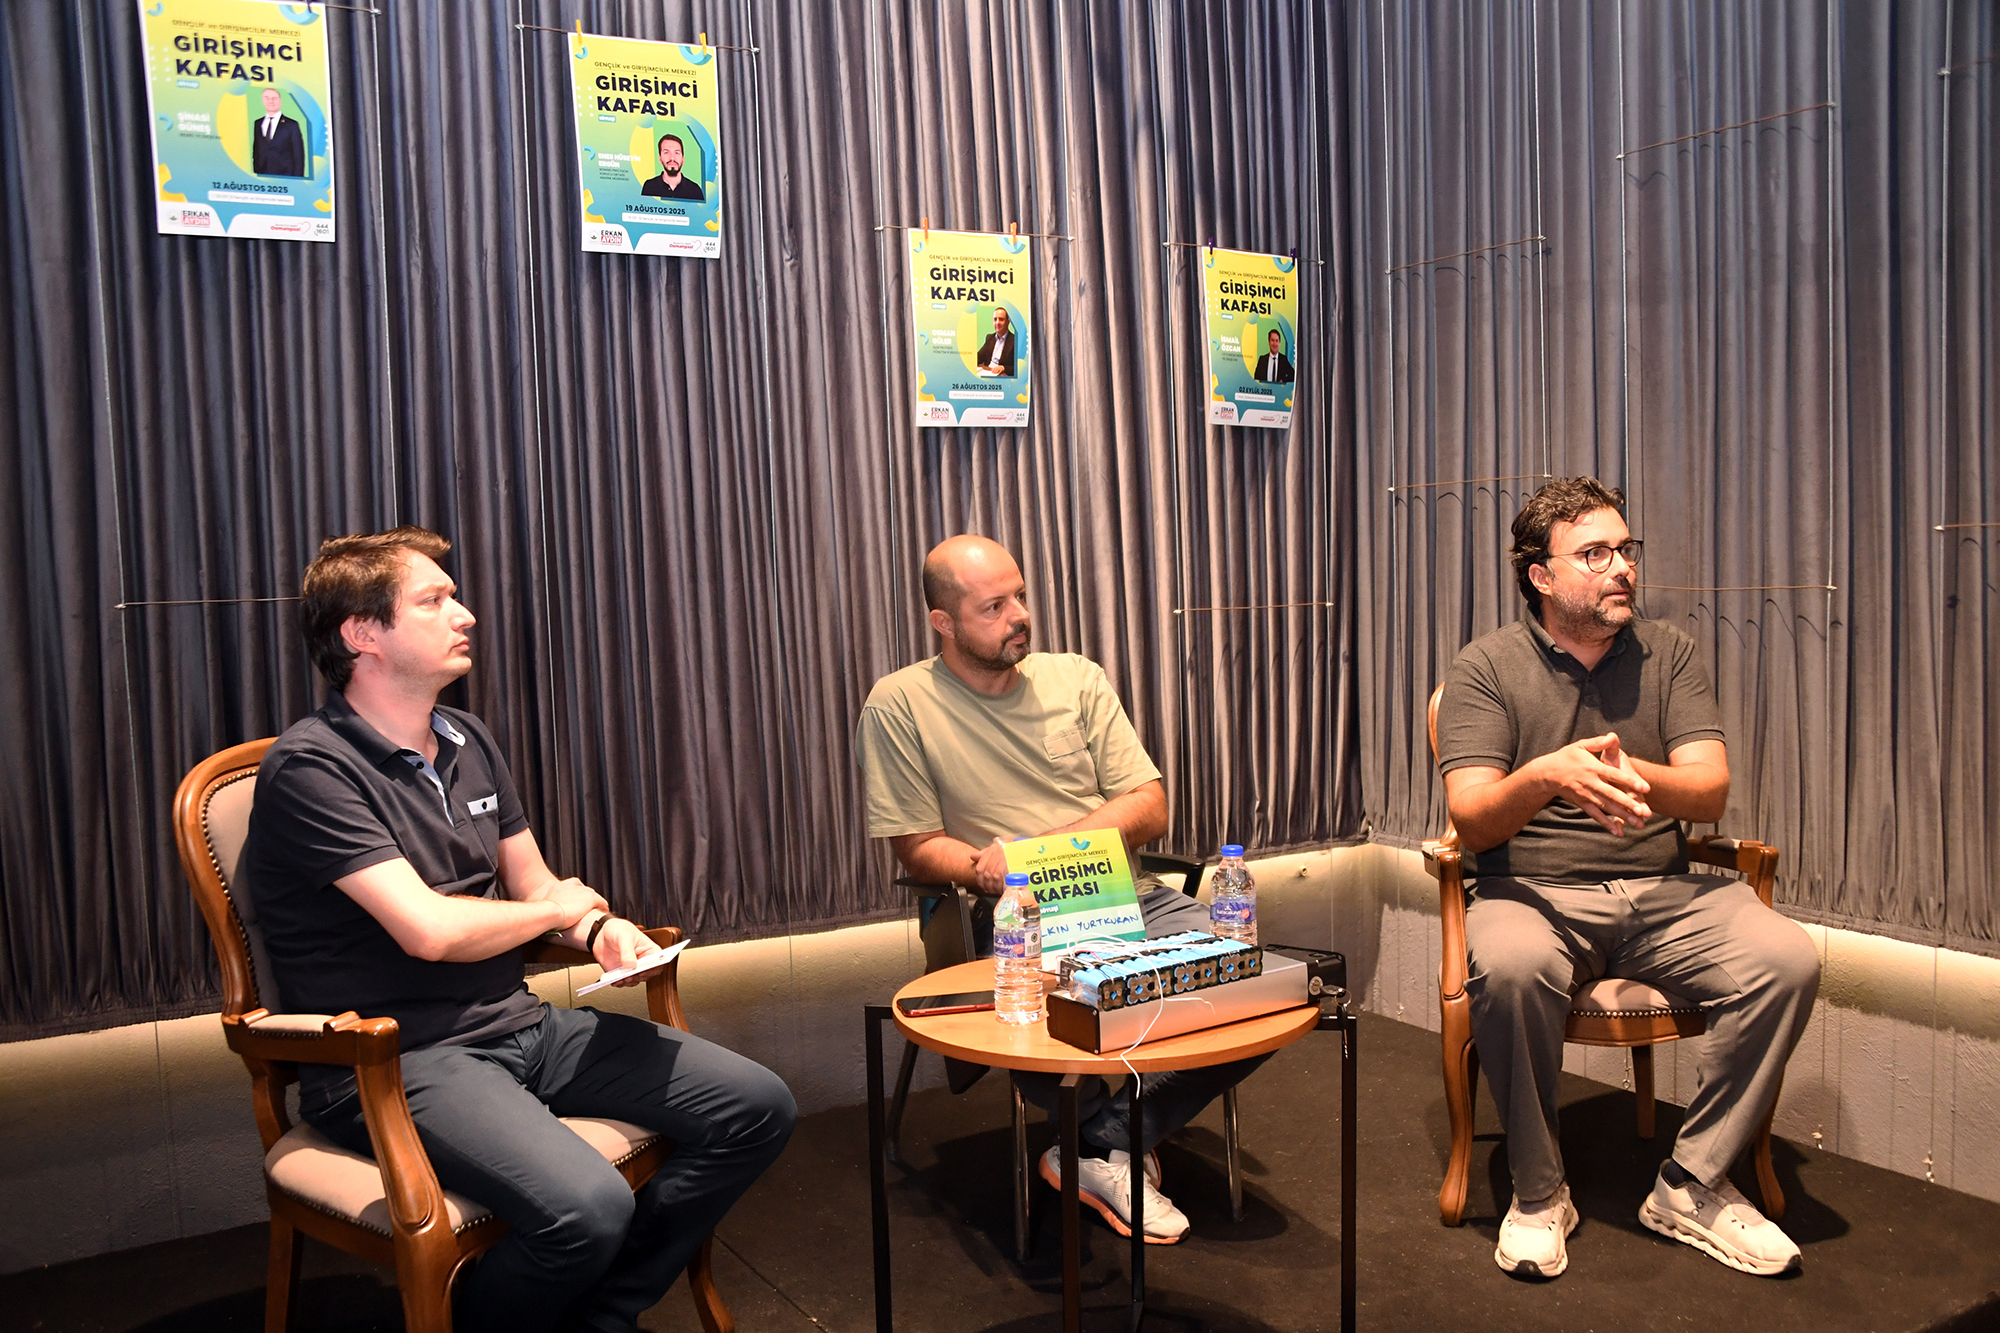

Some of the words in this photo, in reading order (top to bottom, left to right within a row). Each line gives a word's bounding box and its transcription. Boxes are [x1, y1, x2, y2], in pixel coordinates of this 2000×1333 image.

[174, 33, 302, 62] GİRİŞİMCİ
[175, 58, 274, 82] KAFASI
[594, 61, 620, 70] GENÇLİK
[631, 63, 670, 73] GİRİŞİMCİLİK
[595, 73, 698, 98] GİRİŞİMCİ
[597, 96, 676, 117] KAFASI
[212, 181, 221, 189] 12
[223, 181, 265, 192] AĞUSTOS
[267, 185, 288, 193] 2025
[183, 210, 210, 218] ERKAN
[634, 204, 667, 214] AĞUSTOS
[668, 207, 686, 215] 2025
[183, 217, 210, 225] AYDIN
[601, 236, 622, 244] AYDIN
[930, 264, 1014, 284] GİRİŞİMCİ
[931, 286, 995, 302] KAFASI
[1220, 279, 1286, 300] GİRİŞİMCİ
[1221, 298, 1271, 315] KAFASI
[1029, 858, 1113, 885] GİRİŞİMCİ
[1034, 881, 1100, 903] KAFASI
[1077, 914, 1139, 931] YURTKURAN
